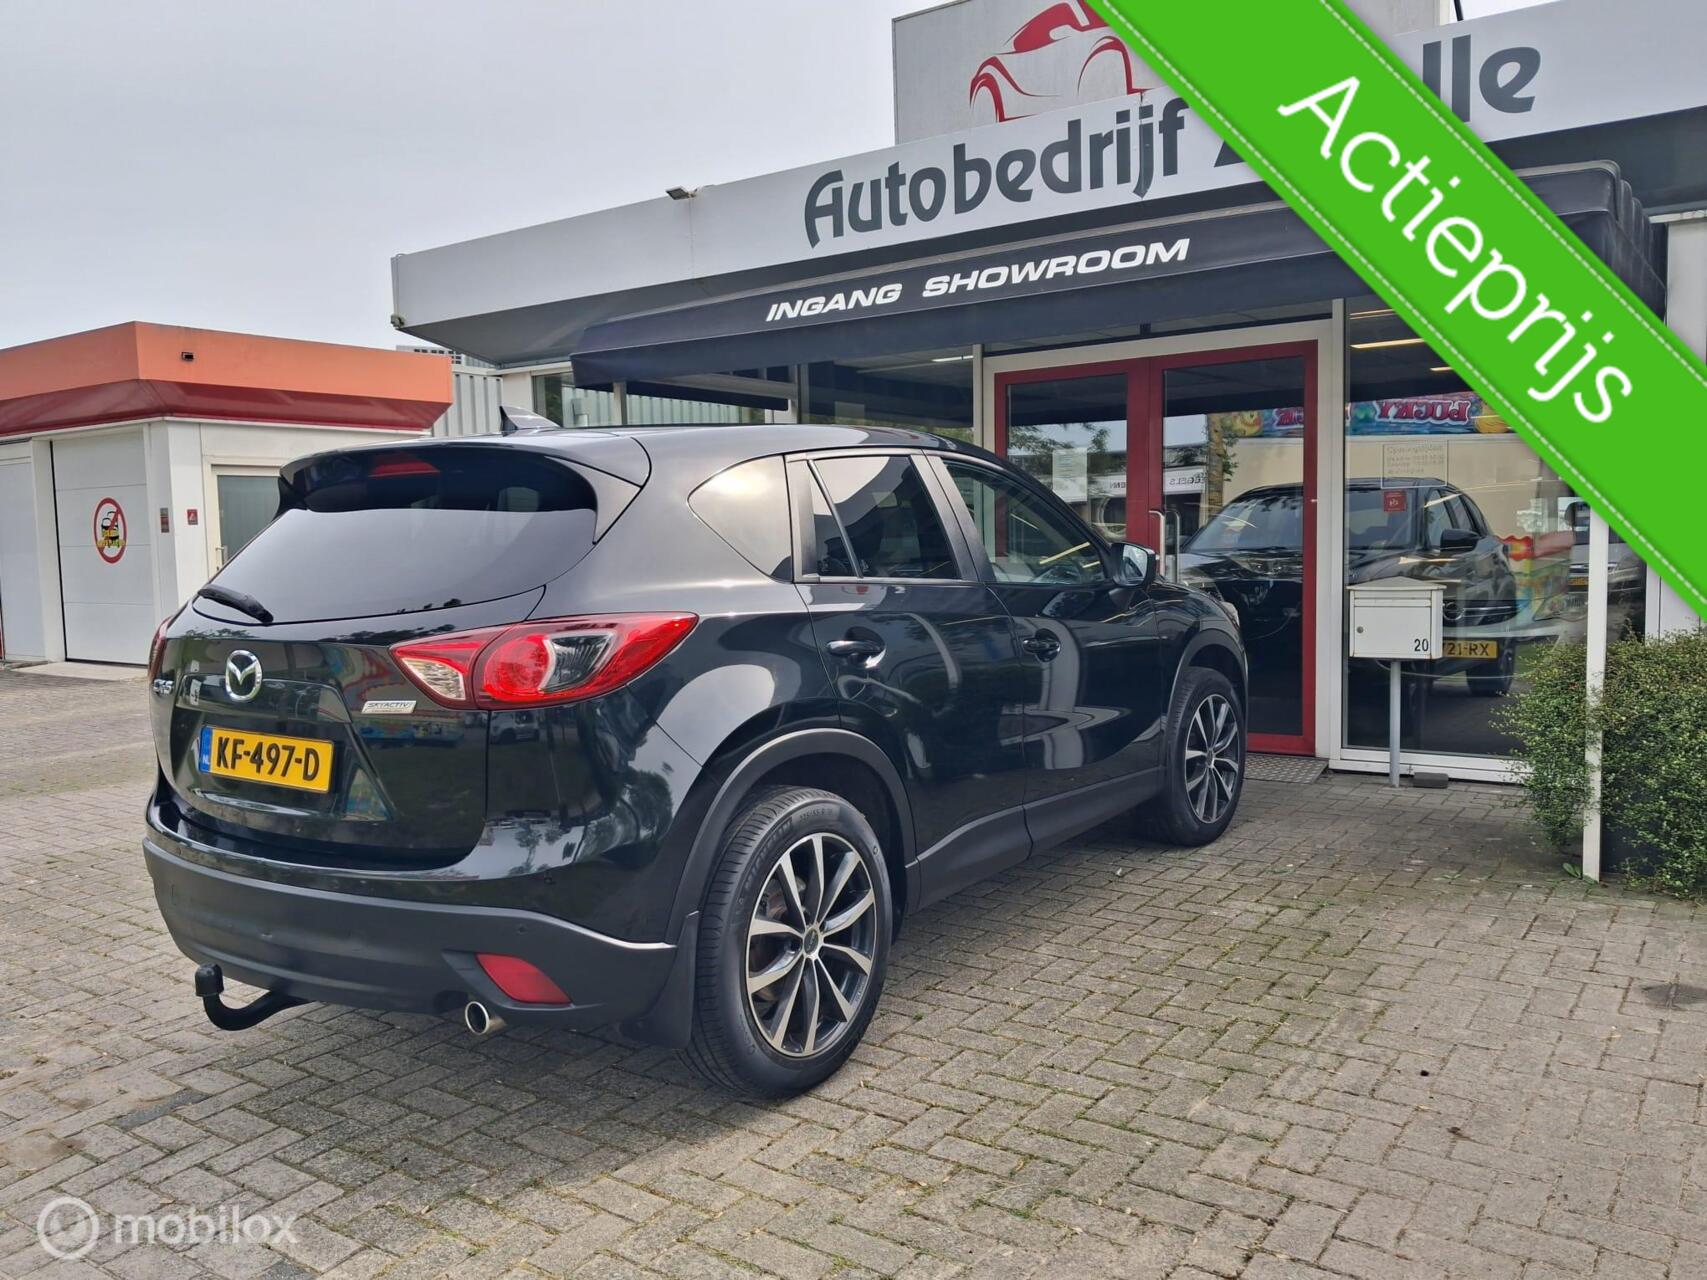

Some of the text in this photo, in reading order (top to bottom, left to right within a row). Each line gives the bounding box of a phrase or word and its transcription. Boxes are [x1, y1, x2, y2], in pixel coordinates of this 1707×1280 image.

[803, 97, 1190, 249] Autobedrijf
[765, 238, 1190, 322] INGANG SHOWROOM
[1414, 638, 1429, 652] 20
[1443, 642, 1489, 656] 21-RX
[216, 736, 320, 781] KF-497-D
